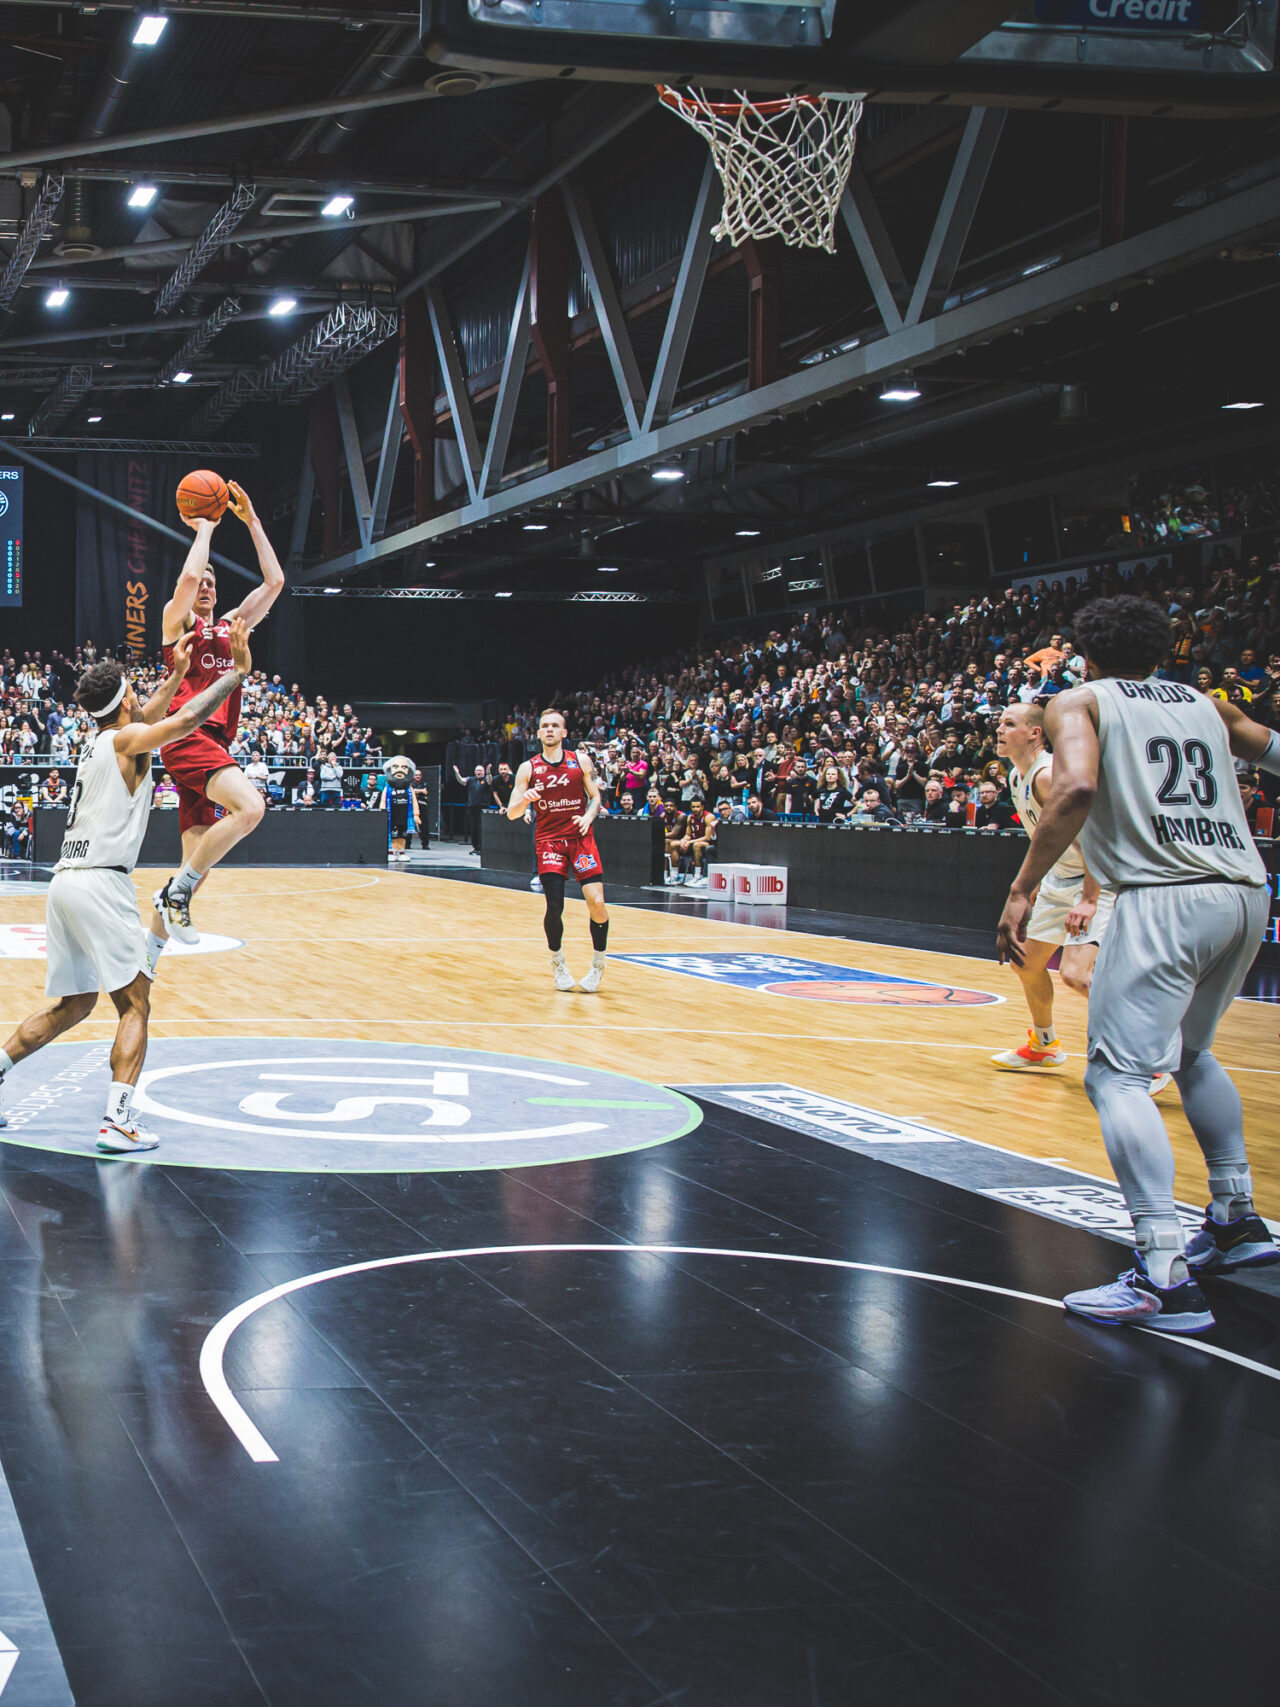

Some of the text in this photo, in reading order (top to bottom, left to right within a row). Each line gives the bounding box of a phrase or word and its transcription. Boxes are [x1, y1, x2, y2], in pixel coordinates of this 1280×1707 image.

[1089, 0, 1191, 22] Credit
[546, 773, 570, 789] 24
[1146, 736, 1218, 809] 23
[548, 799, 581, 808] Staffbase
[790, 1105, 902, 1135] LOTTO
[999, 1190, 1118, 1224] ist so
